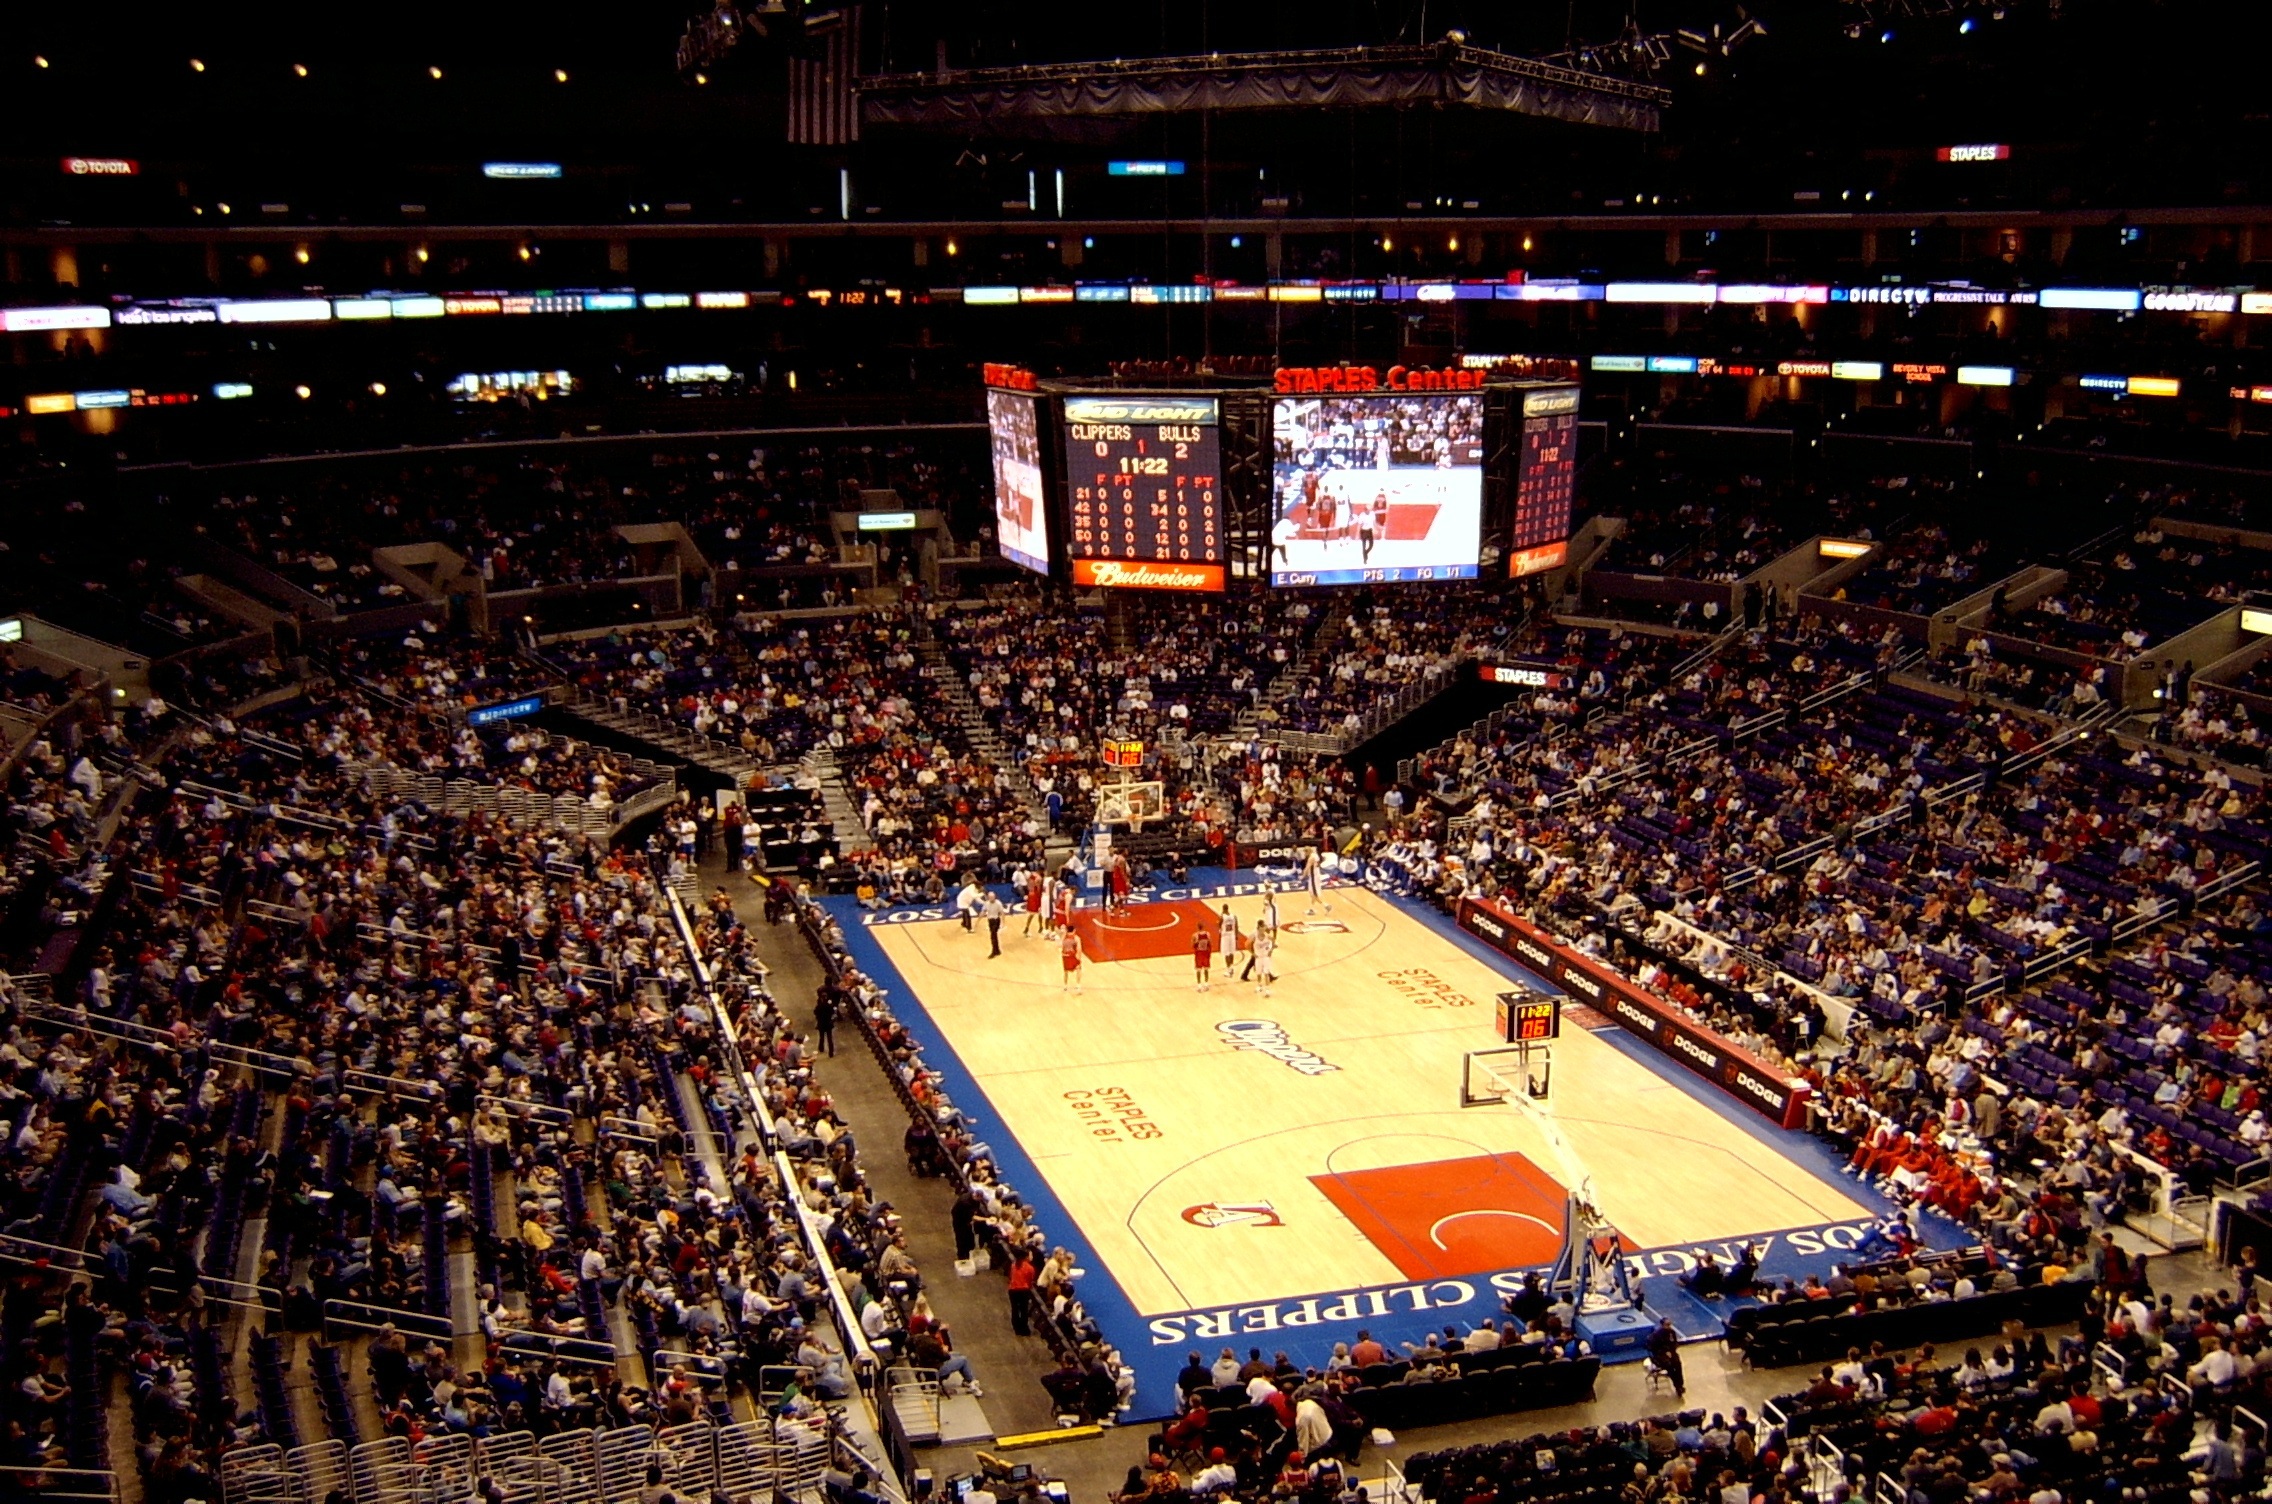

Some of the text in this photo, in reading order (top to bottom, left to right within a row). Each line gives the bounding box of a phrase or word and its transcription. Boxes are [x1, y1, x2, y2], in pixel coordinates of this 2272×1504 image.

[1949, 145, 1997, 161] STAPLES
[87, 161, 131, 173] TOYOTA
[2144, 292, 2236, 312] GOODYEAR
[1791, 363, 1830, 375] TOYOTA
[1274, 366, 1487, 393] STAPLES Center
[1549, 397, 1577, 411] LIGHT
[1131, 408, 1210, 420] LIGHT
[1071, 425, 1201, 442] CLIPPERS BULLS
[1095, 439, 1188, 459] 0 1 2
[1540, 447, 1559, 463] 11:22
[1120, 457, 1168, 475] 11:22
[1096, 474, 1213, 488] F PT F PT
[1076, 488, 1091, 499] 21
[1098, 488, 1107, 500] 0
[1123, 489, 1132, 500] 0
[1177, 490, 1184, 502] 1
[1203, 491, 1213, 502] 0
[1074, 502, 1214, 517] 42 0 0 34 0 0
[1099, 517, 1109, 528] 0
[1124, 518, 1134, 529] 0
[1159, 519, 1168, 530] 2
[1178, 520, 1188, 531] 0
[1204, 520, 1214, 532] 2
[1075, 530, 1215, 546] 50 0 0 12 0 0
[1101, 545, 1110, 556] 0
[1126, 546, 1135, 557] 0
[1156, 547, 1170, 559] 21
[1180, 548, 1189, 560] 0
[1205, 549, 1215, 561] 0
[1516, 552, 1560, 577] Budweiser
[1090, 562, 1206, 587] Budweiser
[1289, 572, 1318, 585] Curry
[1363, 568, 1384, 580] PTS
[1392, 570, 1401, 579] 2
[1417, 568, 1433, 578] FG
[1446, 567, 1460, 577] 1/1
[1494, 667, 1546, 685] STAPLES
[492, 703, 532, 719] DIRECTV
[1122, 752, 1138, 765] 06
[862, 907, 944, 925] LOS
[1472, 913, 1504, 938] DODGE
[1516, 939, 1550, 967] DODGE
[1377, 971, 1442, 1009] Center
[1403, 968, 1475, 1007] STAPLES
[1564, 968, 1601, 998] DODGE
[1520, 1005, 1551, 1019] 11:22
[1616, 1001, 1656, 1032] DODGE
[1522, 1019, 1546, 1038] 06
[1214, 1018, 1343, 1076] Clippers
[1673, 1034, 1717, 1068] DODGE
[1737, 1071, 1783, 1109] DODGE
[1063, 1090, 1123, 1142] Center
[1095, 1086, 1163, 1140] STAPLES
[1149, 1280, 1475, 1346] CLIPPERS
